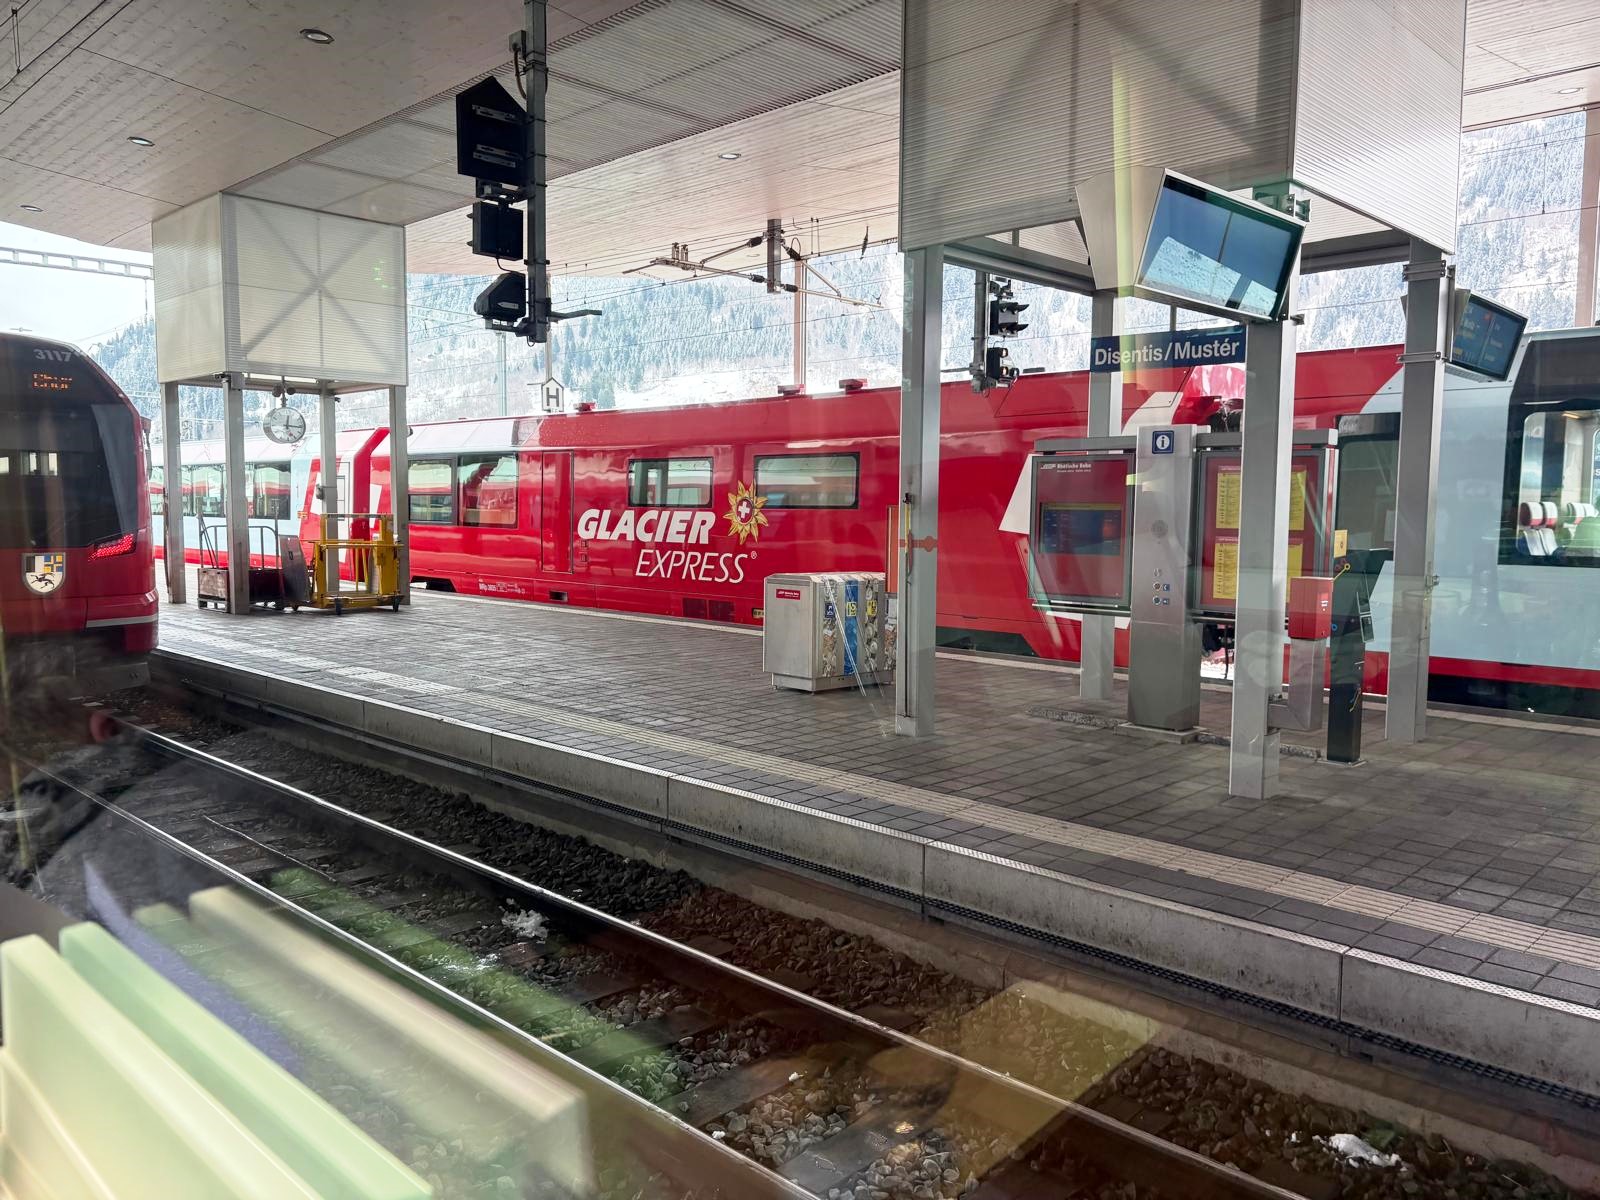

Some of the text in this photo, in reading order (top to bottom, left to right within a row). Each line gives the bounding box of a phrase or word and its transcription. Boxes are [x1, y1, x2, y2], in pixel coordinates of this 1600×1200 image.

[33, 349, 72, 362] 3117
[1094, 338, 1240, 366] Disentis/Mustér
[546, 387, 560, 407] H
[577, 508, 716, 545] GLACIER
